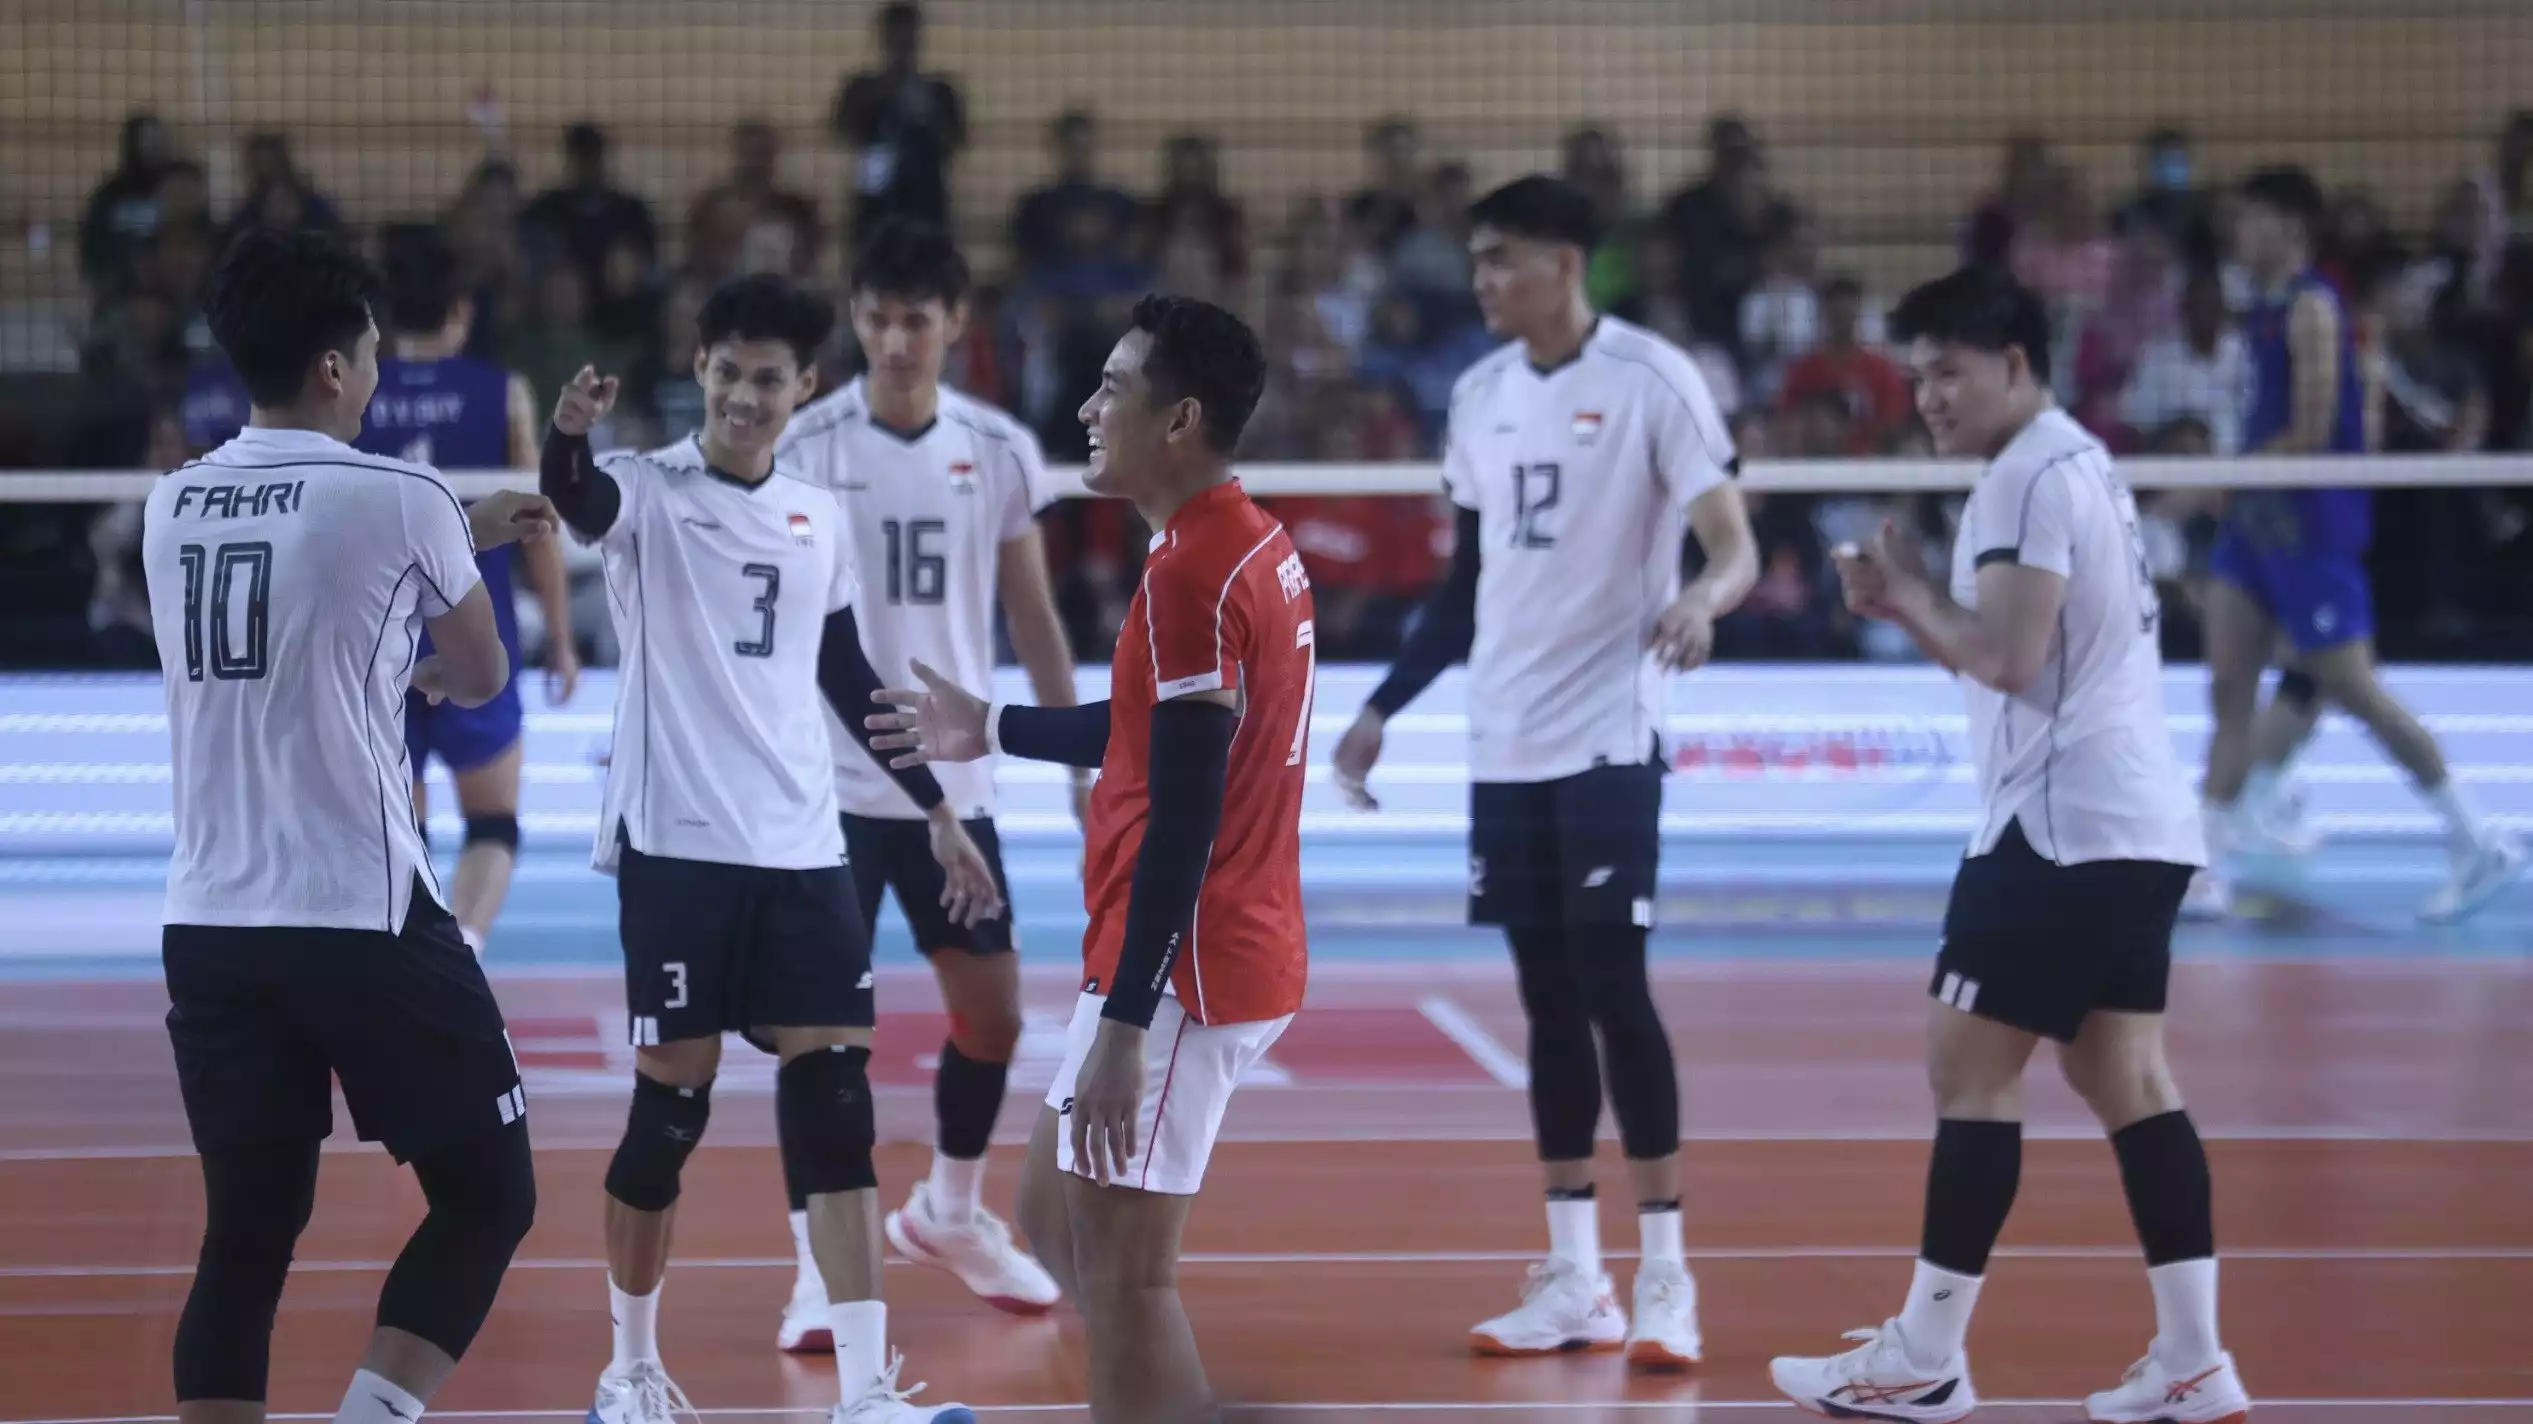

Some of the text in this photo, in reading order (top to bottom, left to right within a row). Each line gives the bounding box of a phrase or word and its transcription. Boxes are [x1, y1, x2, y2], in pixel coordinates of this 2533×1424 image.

[173, 479, 306, 519] FAHRI
[1511, 463, 1560, 550] 12
[881, 517, 946, 606] 16
[179, 540, 273, 682] 10
[734, 562, 780, 659] 3
[1285, 619, 1316, 767] 7
[661, 961, 688, 1010] 3
